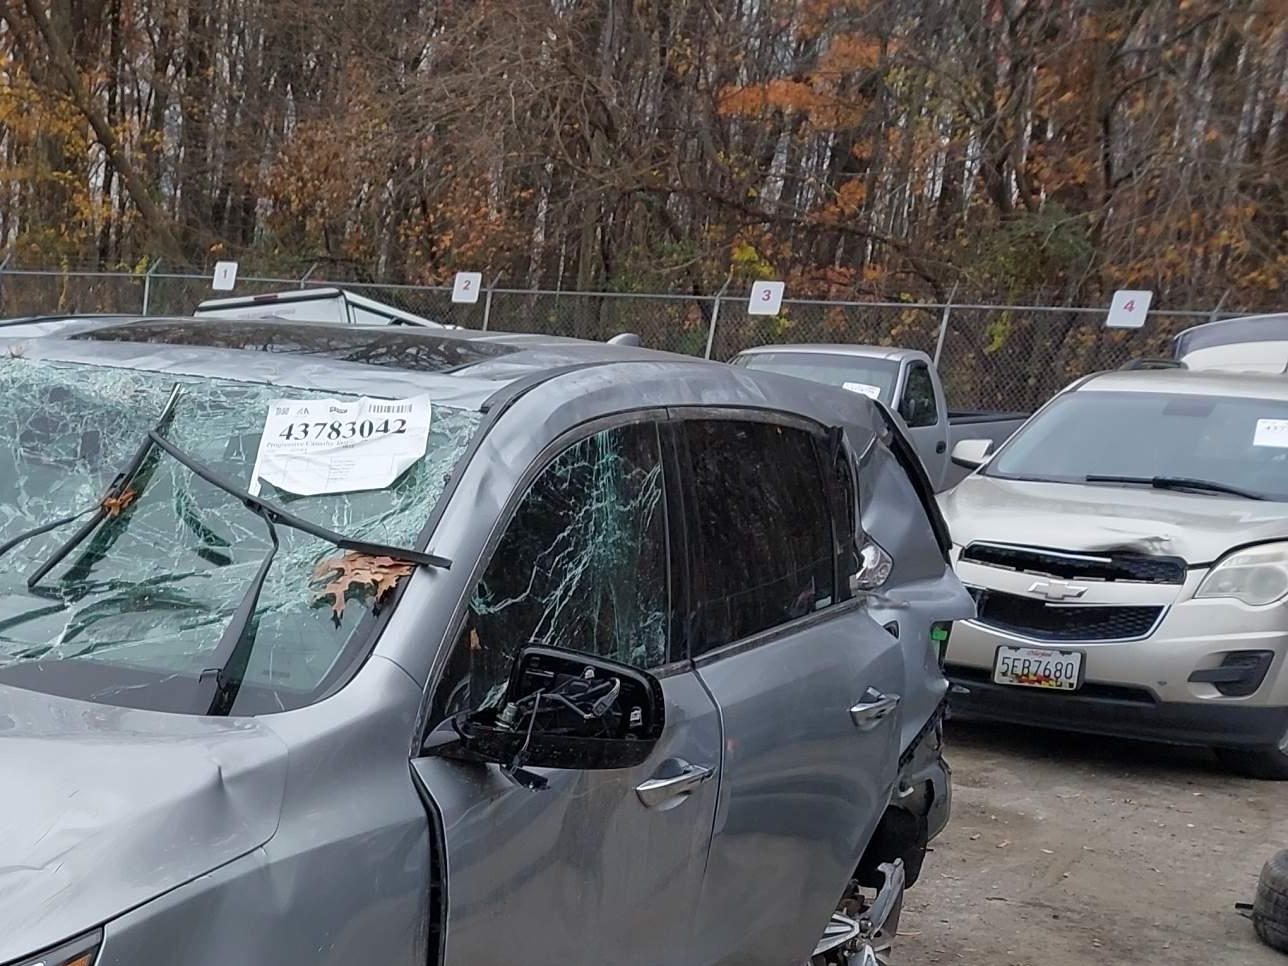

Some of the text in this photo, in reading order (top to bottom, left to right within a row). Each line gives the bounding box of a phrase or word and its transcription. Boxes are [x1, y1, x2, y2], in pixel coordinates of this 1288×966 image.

[462, 279, 471, 290] 2
[761, 289, 772, 301] 3
[1123, 299, 1136, 312] 4
[279, 418, 407, 441] 43783042
[1000, 656, 1074, 680] 5EB7680
